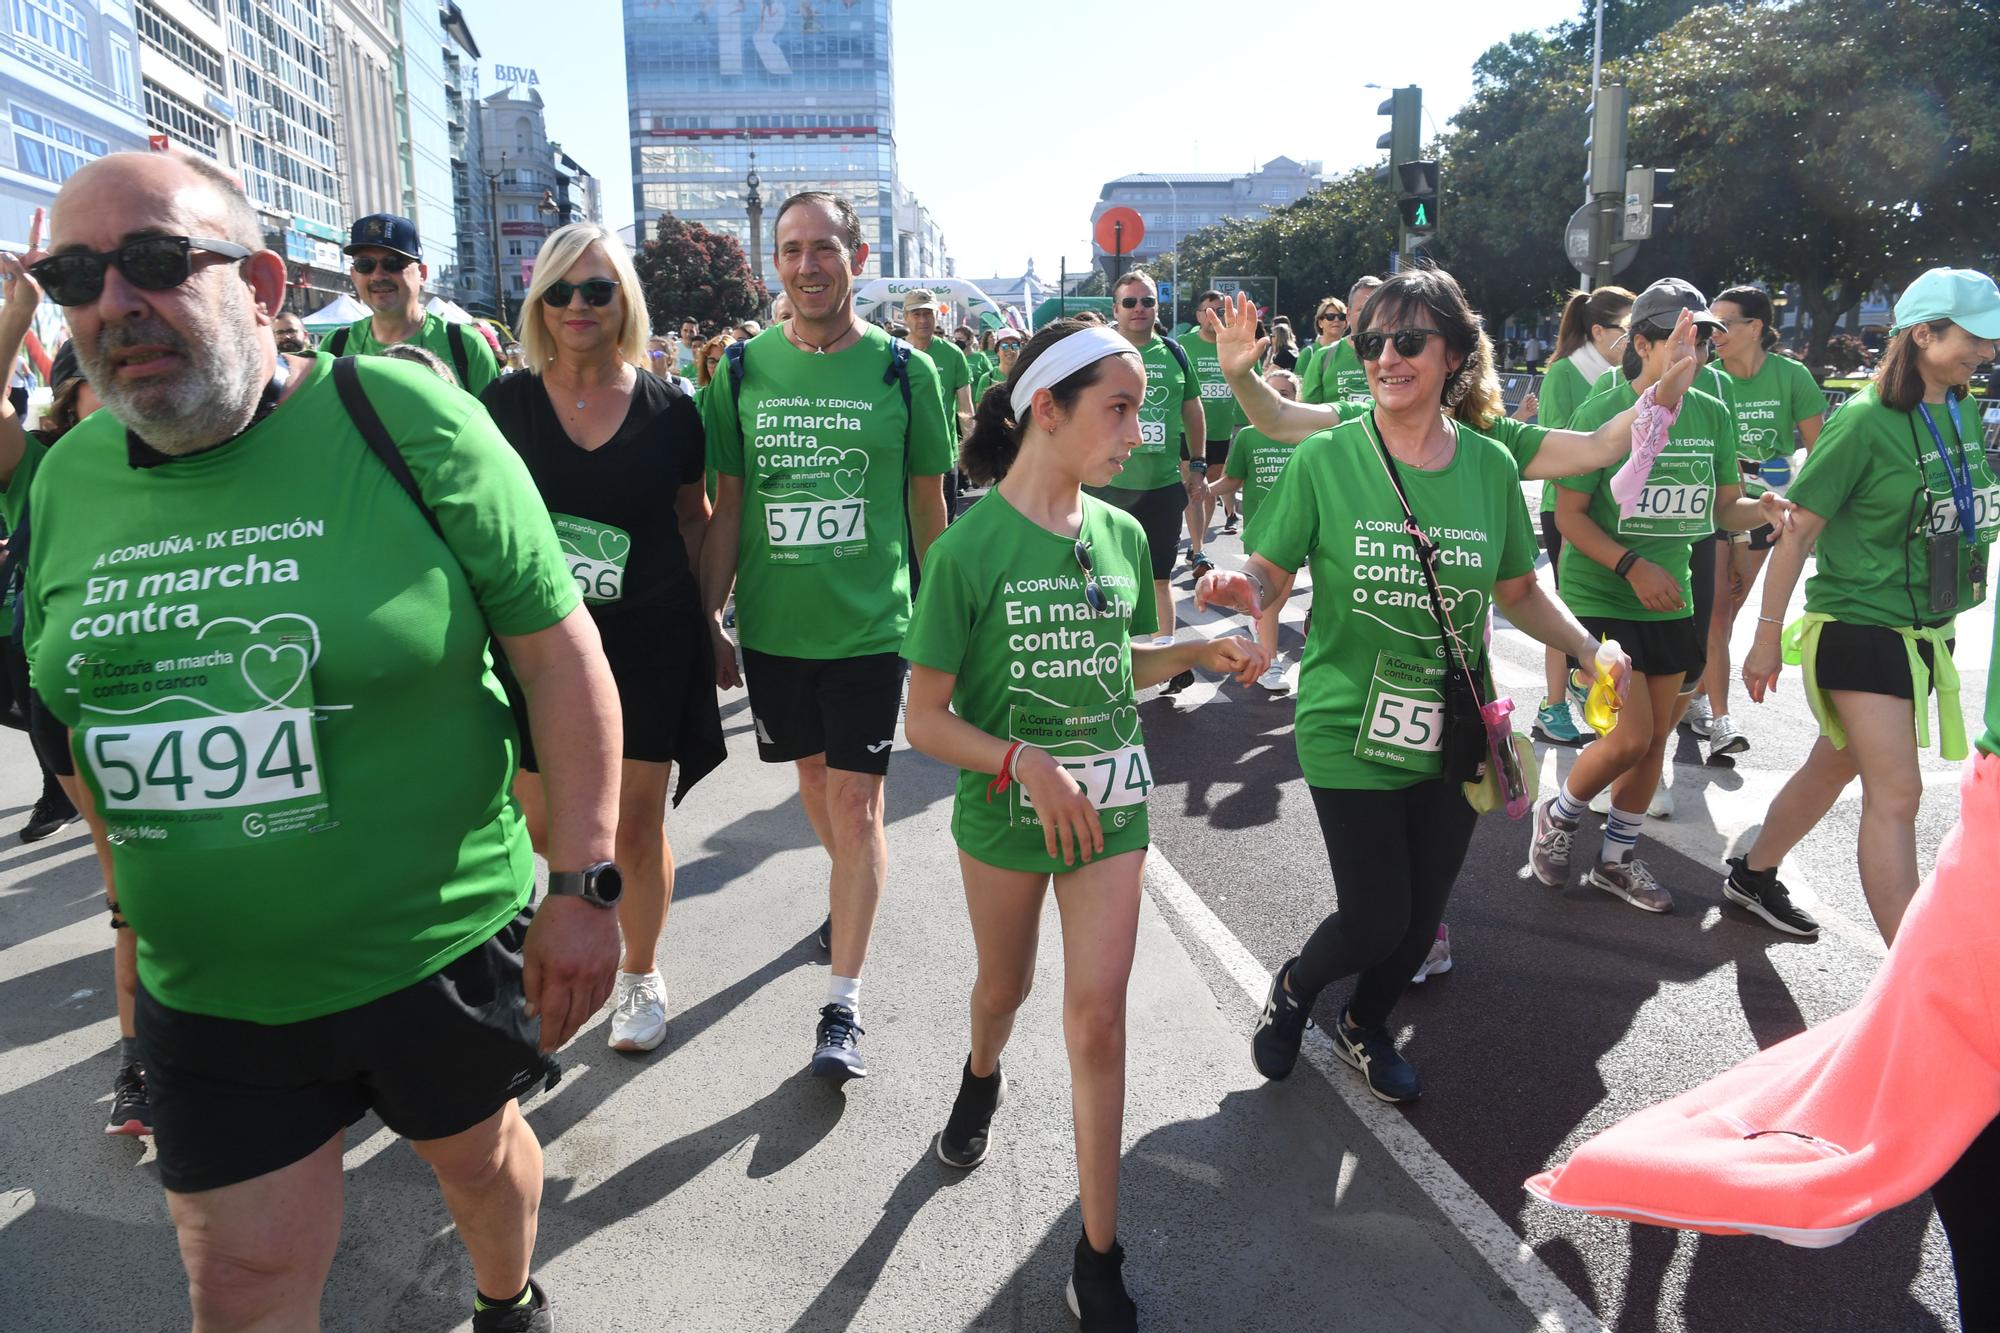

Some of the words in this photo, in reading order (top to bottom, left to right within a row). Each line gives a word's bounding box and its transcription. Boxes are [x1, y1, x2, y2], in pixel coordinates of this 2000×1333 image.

[495, 64, 540, 84] BBVA
[1146, 370, 1163, 379] cha
[757, 401, 765, 409] A
[765, 396, 810, 408] CORUÑA
[816, 398, 828, 408] IX
[828, 399, 873, 411] EDICIÓN
[756, 413, 778, 429] En
[783, 413, 861, 431] marcha
[1738, 409, 1775, 419] archa
[755, 431, 818, 448] contra
[1142, 425, 1164, 442] 63
[757, 455, 767, 467] o
[1254, 456, 1264, 464] En
[1636, 487, 1708, 514] 4016
[569, 523, 598, 536] marcha
[768, 503, 862, 542] 5767
[1355, 520, 1364, 530] A
[1366, 521, 1408, 534] CORU
[1429, 526, 1442, 538] IX
[1444, 528, 1488, 543] EDICIÓN
[93, 554, 106, 571] A
[108, 535, 194, 565] CORUÑA
[206, 531, 227, 550] IX
[231, 516, 325, 547] EDICIÓN
[1355, 536, 1385, 557] En
[1393, 545, 1482, 568] mcha
[83, 576, 129, 606] En
[136, 554, 299, 599] marcha
[571, 562, 618, 598] 66
[1004, 582, 1014, 594] A
[1016, 575, 1079, 593] CORUÑA
[1353, 588, 1368, 603] o
[1374, 589, 1456, 612] canco
[69, 602, 200, 641] contra
[1005, 601, 1042, 625] En
[1008, 626, 1096, 652] contra
[104, 659, 153, 678] Coruña
[155, 659, 175, 672] en
[177, 649, 235, 669] marcha
[1010, 661, 1026, 679] o
[1031, 656, 1118, 679] cancro
[1386, 658, 1393, 666] A
[1394, 658, 1424, 674] Coruña
[1384, 669, 1413, 681] contra
[92, 681, 140, 698] contra
[143, 681, 153, 692] o
[155, 675, 208, 690] cancro
[1028, 713, 1063, 726] Coruña
[1065, 717, 1078, 726] en
[1080, 712, 1111, 724] marcha
[1020, 727, 1053, 737] contra
[1055, 728, 1063, 737] o
[1064, 727, 1098, 738] cancro
[94, 720, 313, 802] 5494
[1364, 747, 1374, 756] 29
[1375, 748, 1385, 758] de
[1386, 753, 1406, 763] Maio
[1020, 816, 1031, 825] 29
